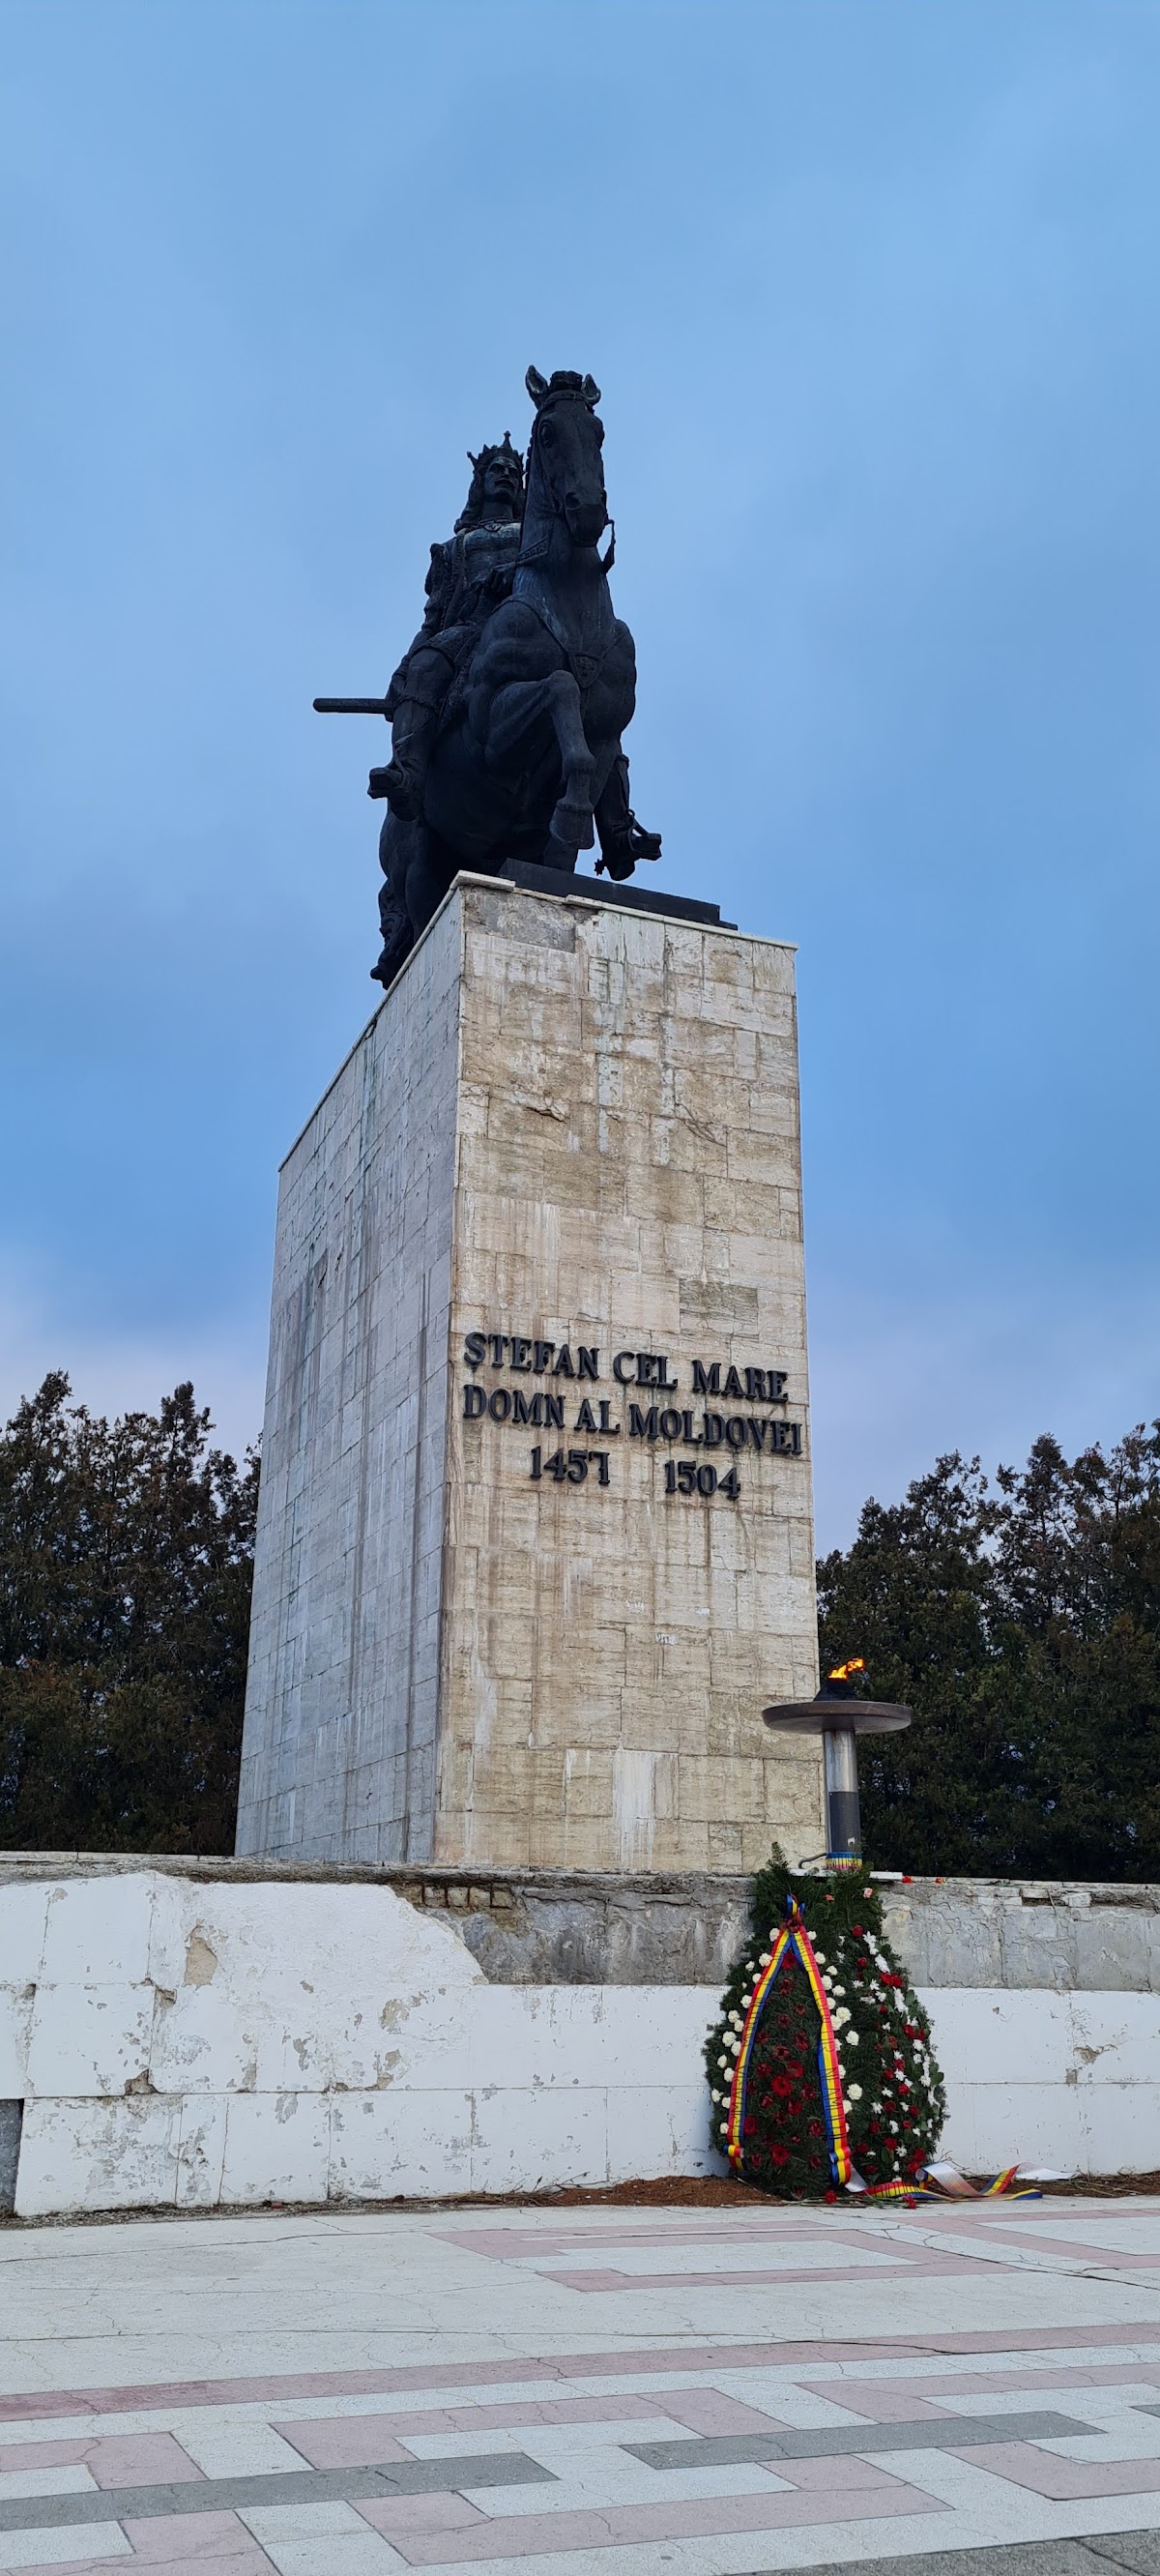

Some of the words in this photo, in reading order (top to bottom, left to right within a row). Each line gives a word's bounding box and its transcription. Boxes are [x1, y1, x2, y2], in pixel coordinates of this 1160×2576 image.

[464, 1332, 599, 1380] ȘTEFAN
[613, 1351, 678, 1390] CEL
[692, 1360, 789, 1402] MARE
[463, 1385, 566, 1428] DOMN
[574, 1398, 621, 1434] AL
[629, 1403, 802, 1455] MOLDOVEI
[530, 1446, 611, 1485] 1457
[665, 1459, 741, 1499] 1504
